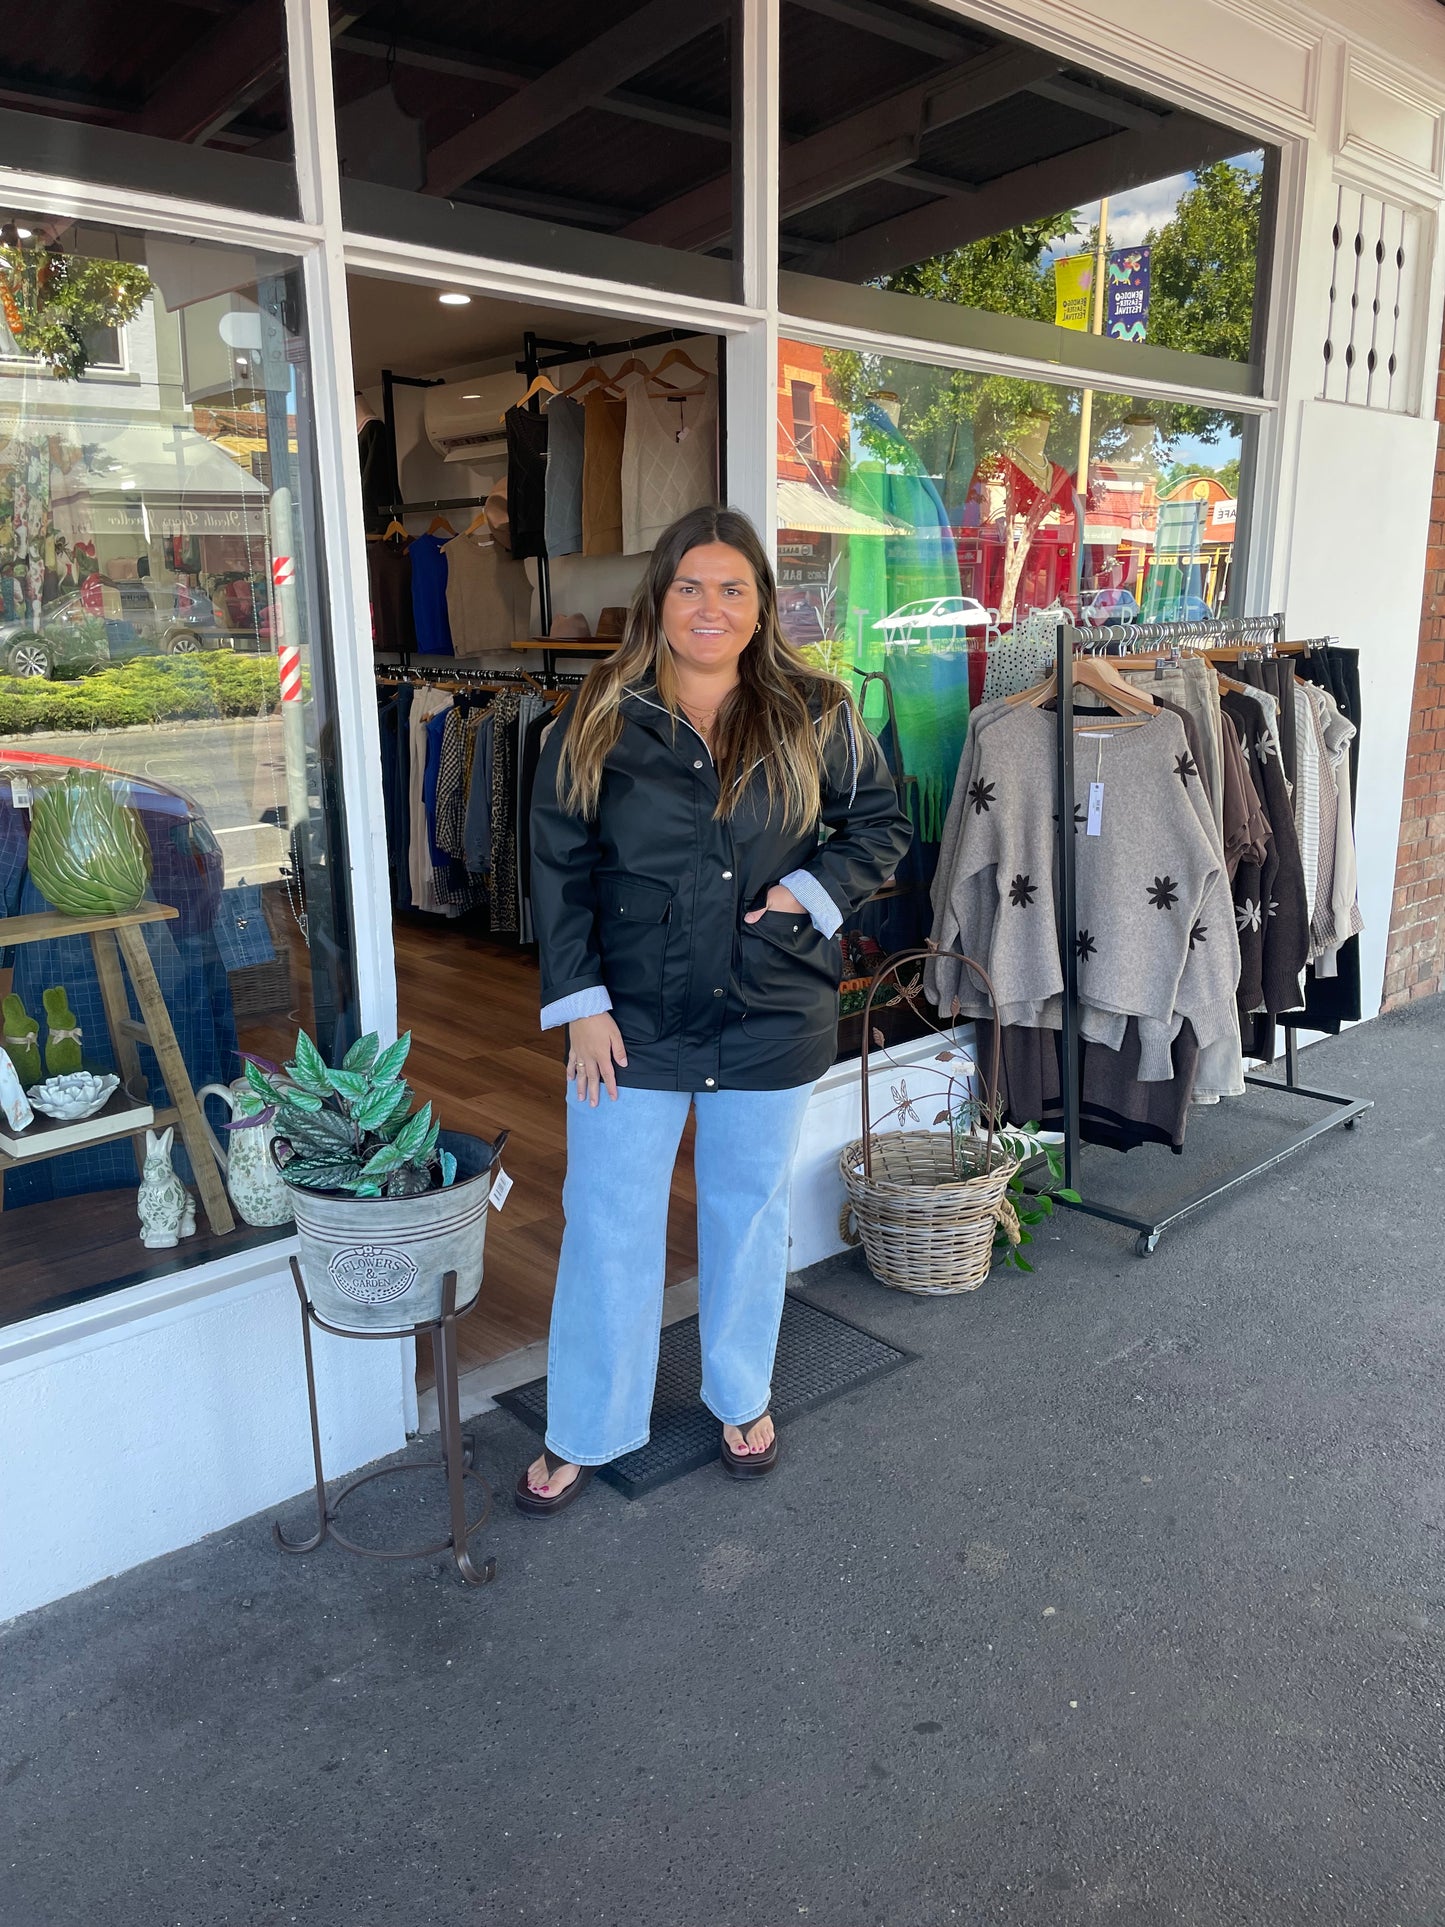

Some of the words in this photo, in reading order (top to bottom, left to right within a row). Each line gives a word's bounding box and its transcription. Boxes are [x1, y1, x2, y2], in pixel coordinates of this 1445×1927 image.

[853, 607, 957, 658] TWO
[341, 1258, 402, 1273] FLOWERS
[365, 1268, 377, 1279] &
[352, 1278, 391, 1288] GARDEN
